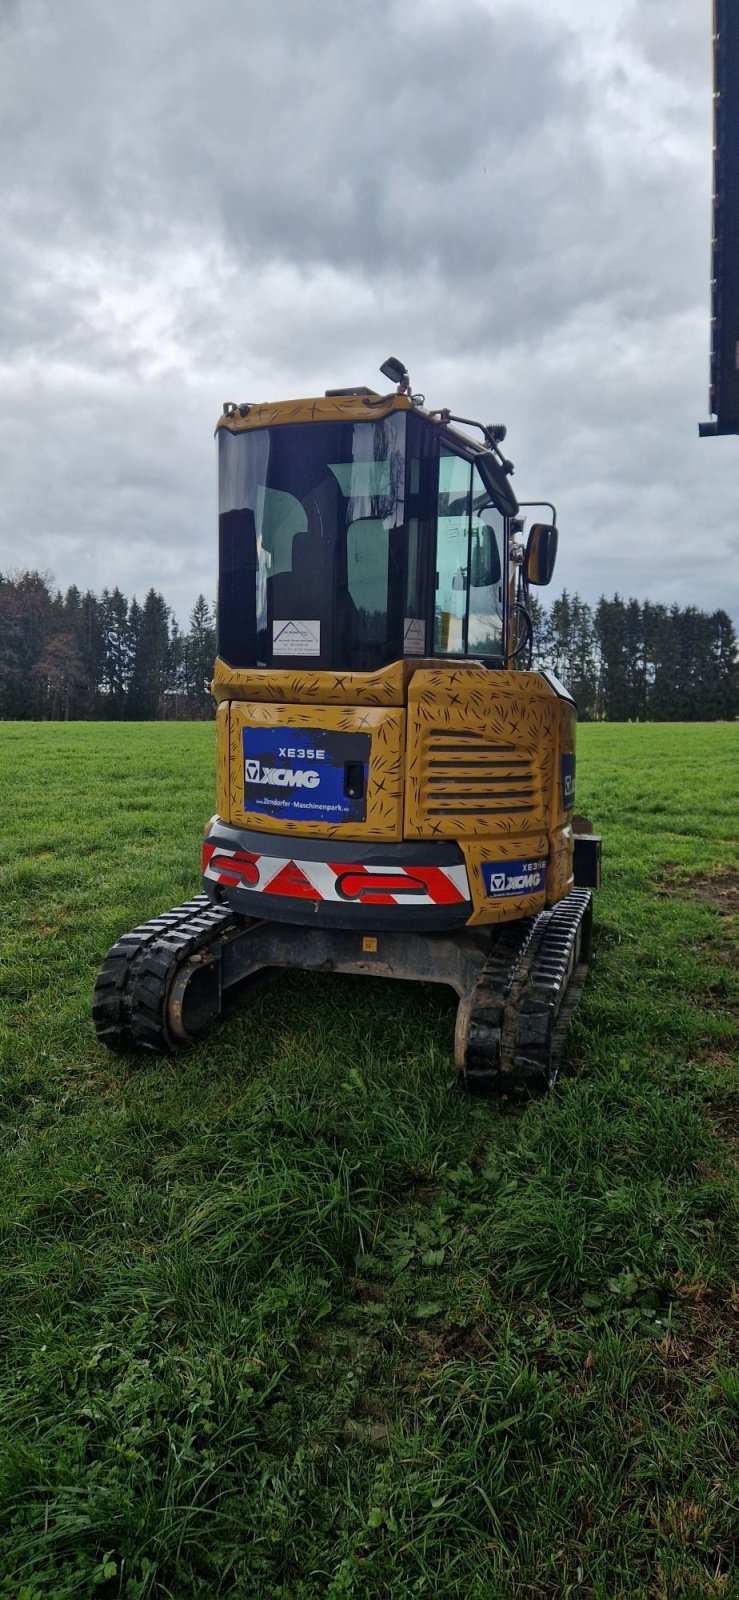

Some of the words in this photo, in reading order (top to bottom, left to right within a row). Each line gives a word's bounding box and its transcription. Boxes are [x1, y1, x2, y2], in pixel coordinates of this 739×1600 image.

[278, 748, 325, 759] XE35E
[260, 768, 320, 788] XCMG
[505, 873, 541, 890] XCMG
